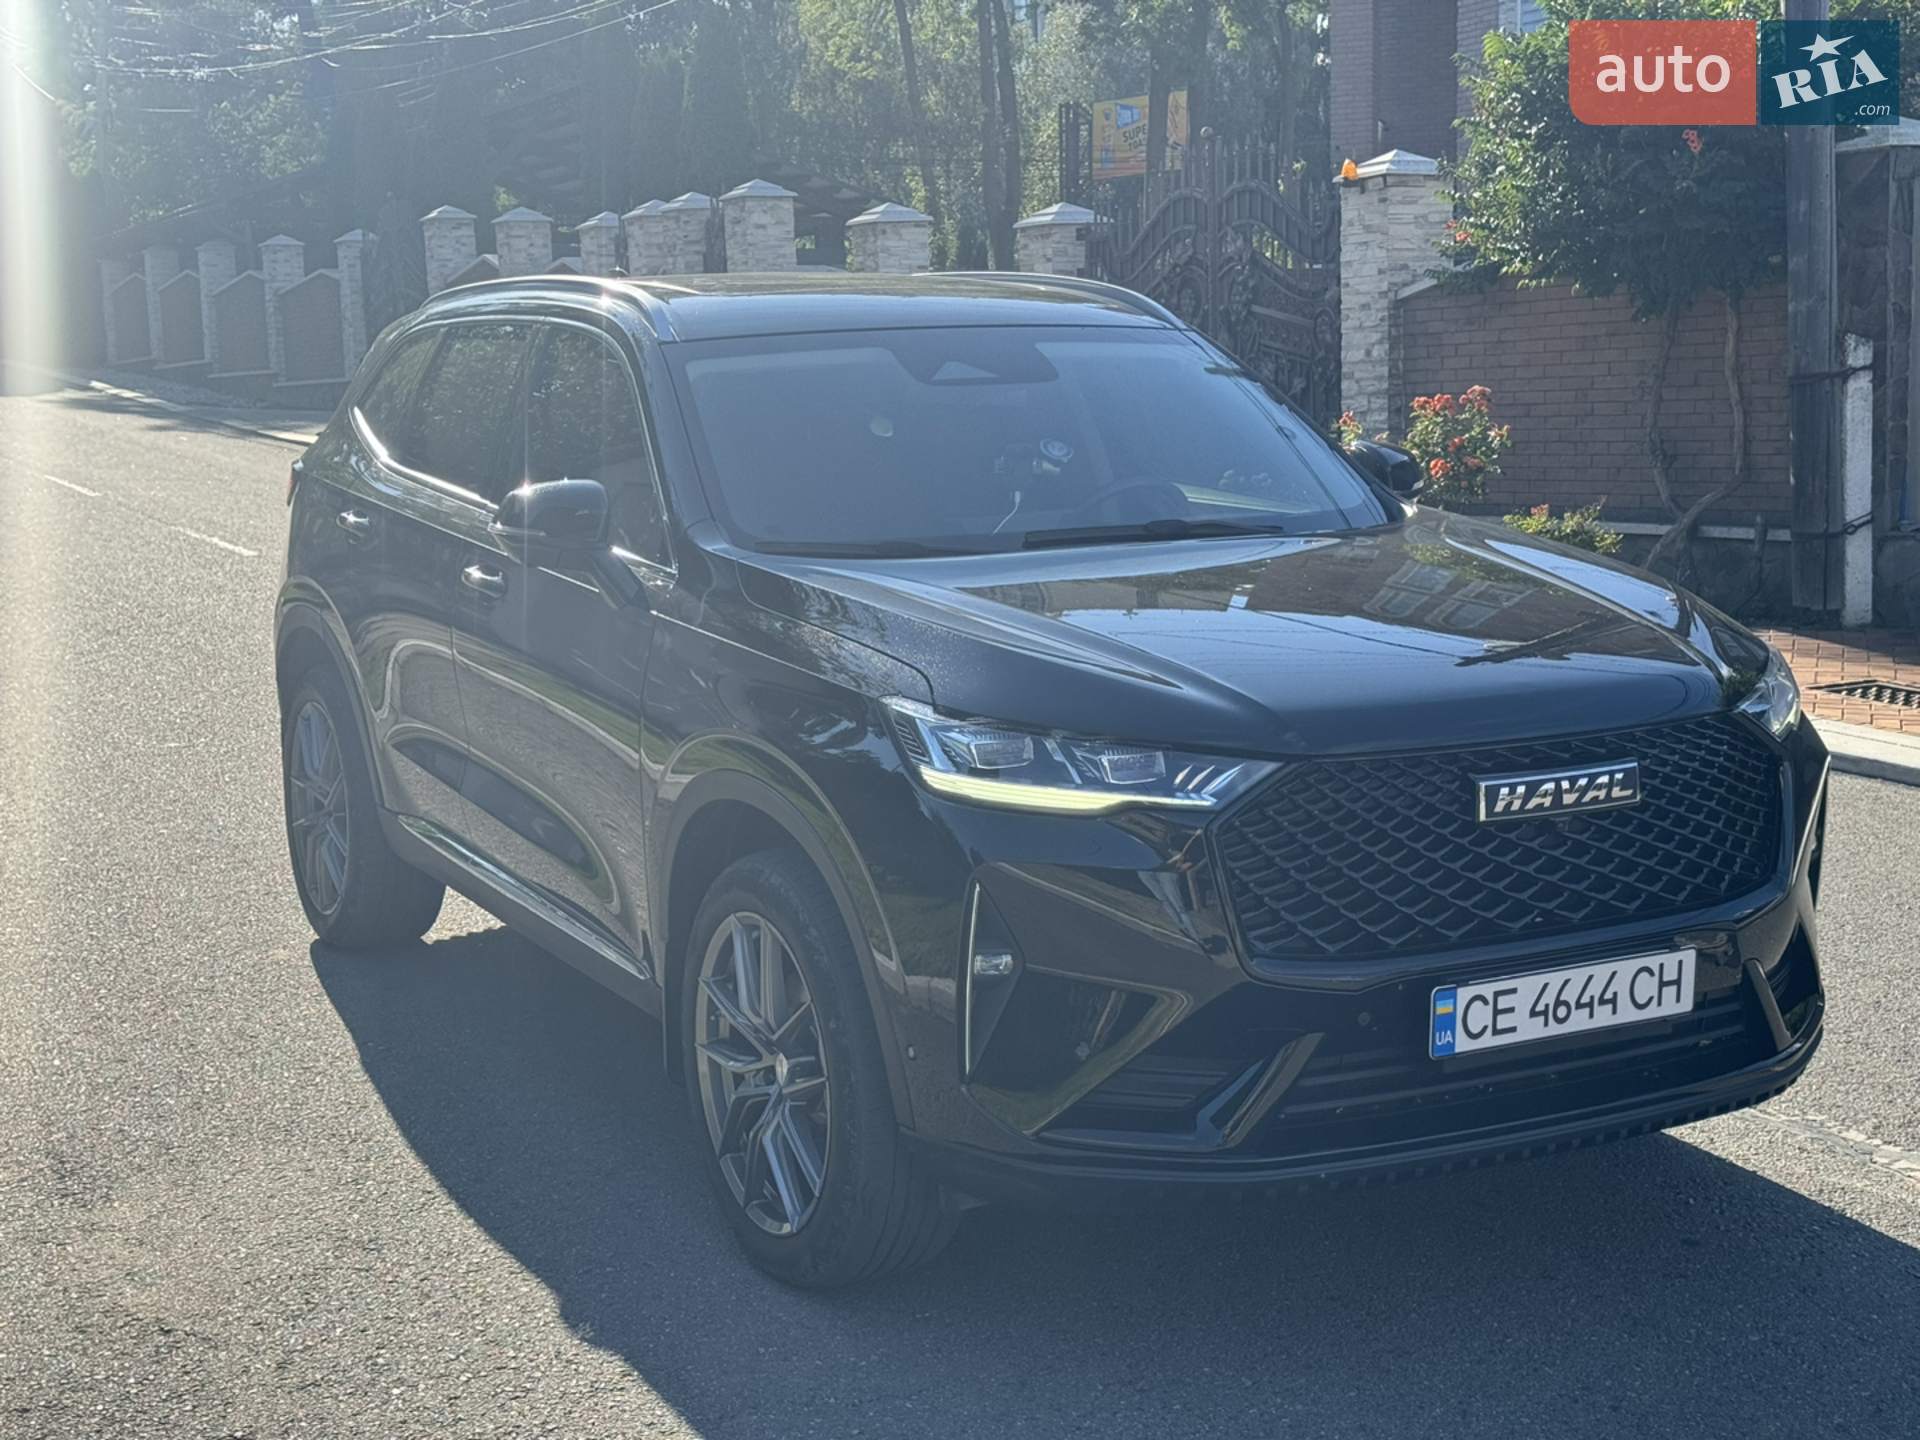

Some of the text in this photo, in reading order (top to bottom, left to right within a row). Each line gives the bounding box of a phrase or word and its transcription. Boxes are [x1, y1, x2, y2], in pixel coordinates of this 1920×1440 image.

[1122, 123, 1148, 144] SUPE
[1493, 772, 1634, 813] HAVAL
[1461, 959, 1683, 1041] CE 4644 CH
[1435, 1030, 1453, 1046] UA
